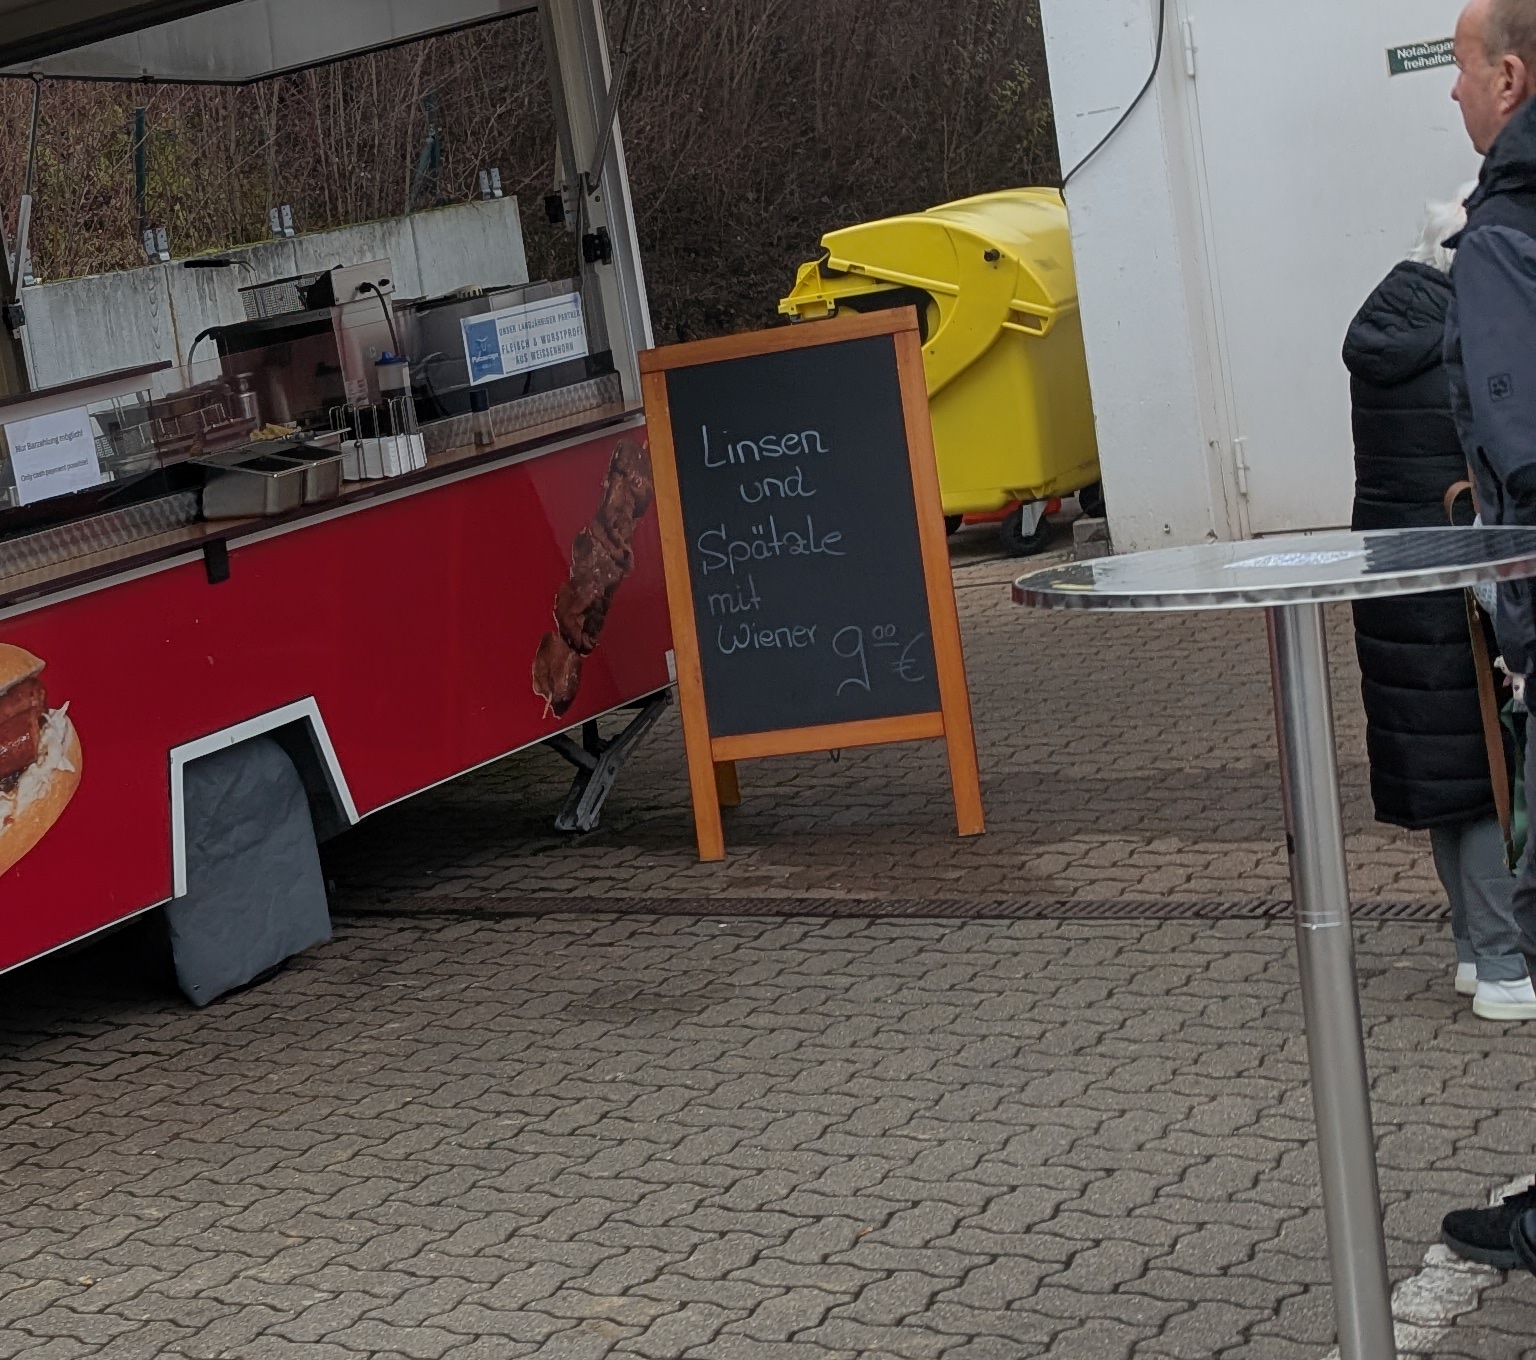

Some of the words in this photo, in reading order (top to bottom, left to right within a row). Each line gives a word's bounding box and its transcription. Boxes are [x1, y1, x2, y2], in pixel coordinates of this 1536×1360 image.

[1397, 41, 1454, 59] Notausga
[558, 309, 581, 322] PARTNER
[501, 339, 530, 354] FLEISCH
[540, 326, 583, 344] WURSTPROFI
[515, 353, 528, 365] AUS
[702, 425, 829, 468] Linsen
[739, 466, 817, 504] und
[707, 574, 763, 619] mit
[716, 621, 818, 655] Wiener
